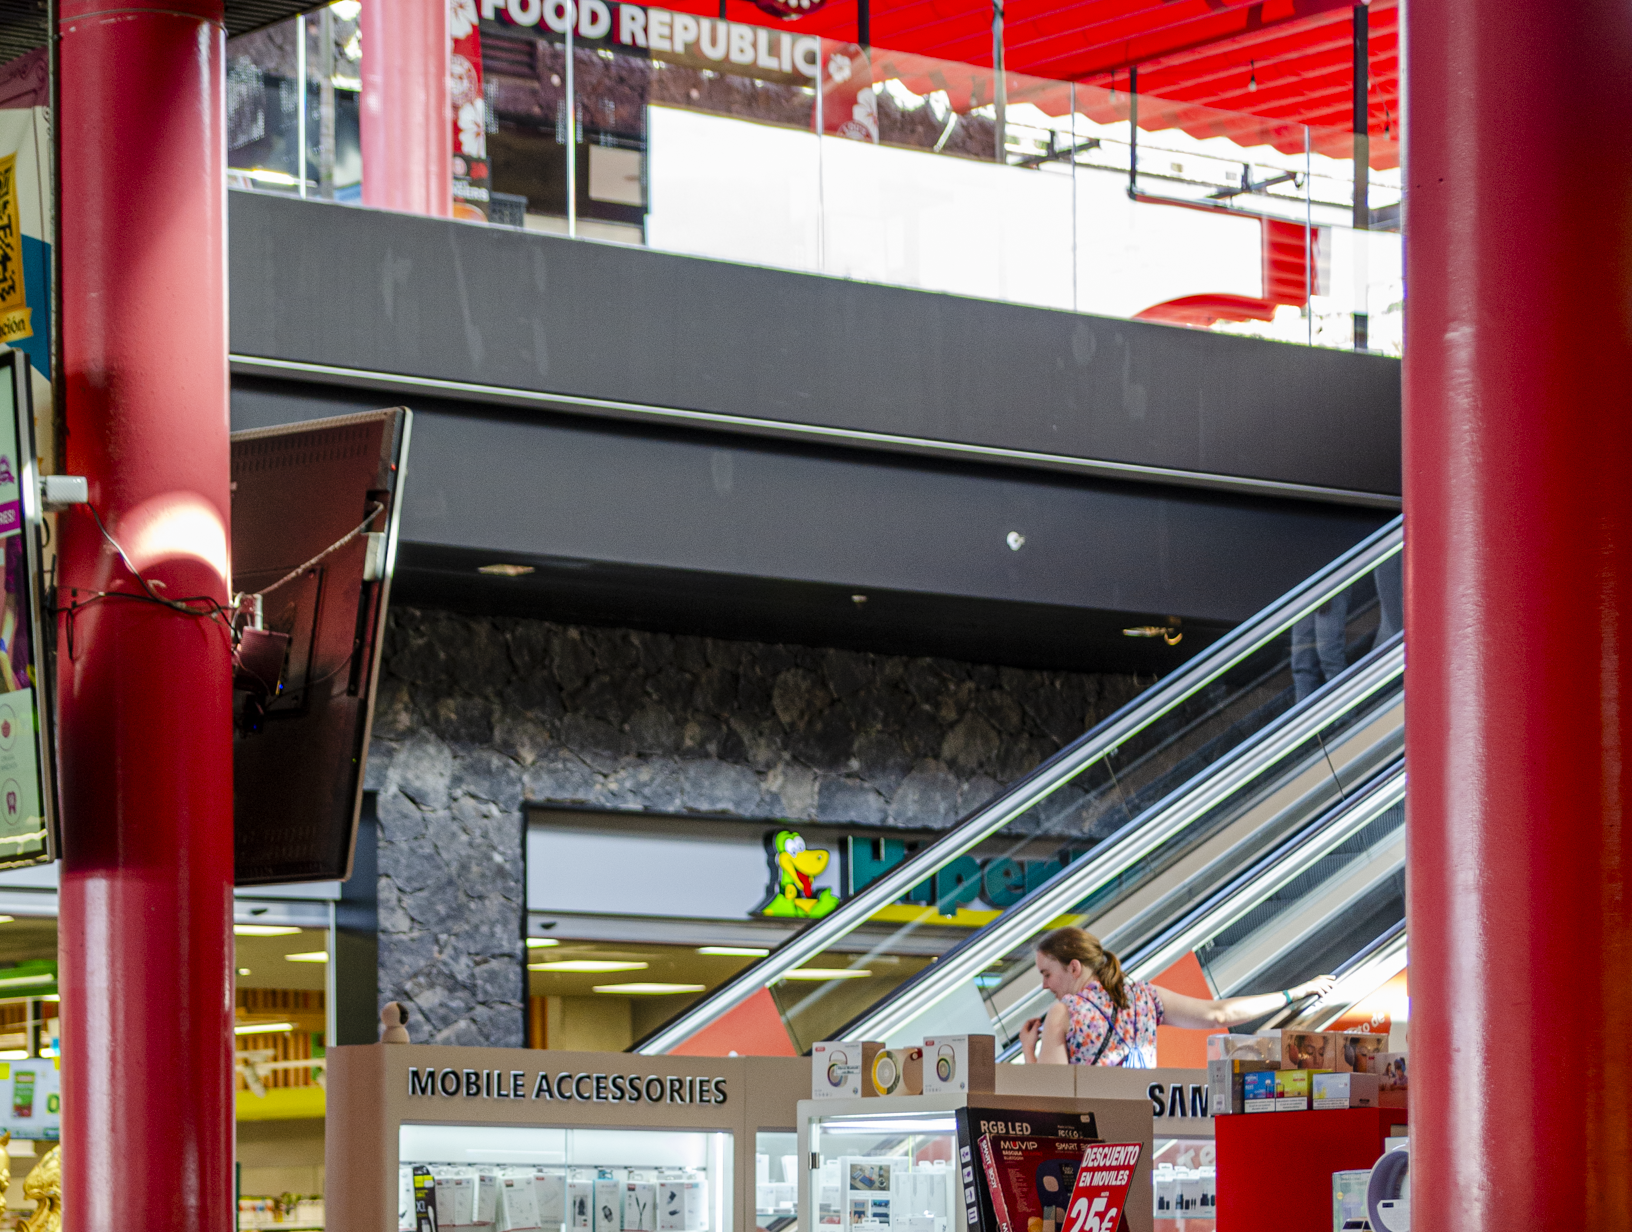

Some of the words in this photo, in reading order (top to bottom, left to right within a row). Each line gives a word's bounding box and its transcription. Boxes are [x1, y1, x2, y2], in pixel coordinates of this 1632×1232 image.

[619, 4, 818, 78] REPUBLIC
[408, 1067, 526, 1099] MOBILE
[532, 1071, 728, 1104] ACCESSORIES
[980, 1120, 1006, 1134] RGB
[1008, 1122, 1031, 1135] LED
[1001, 1141, 1038, 1150] MUVIP
[1081, 1145, 1140, 1168] DESCUENTO
[1079, 1172, 1093, 1187] EN
[1091, 1170, 1130, 1186] MOVILES
